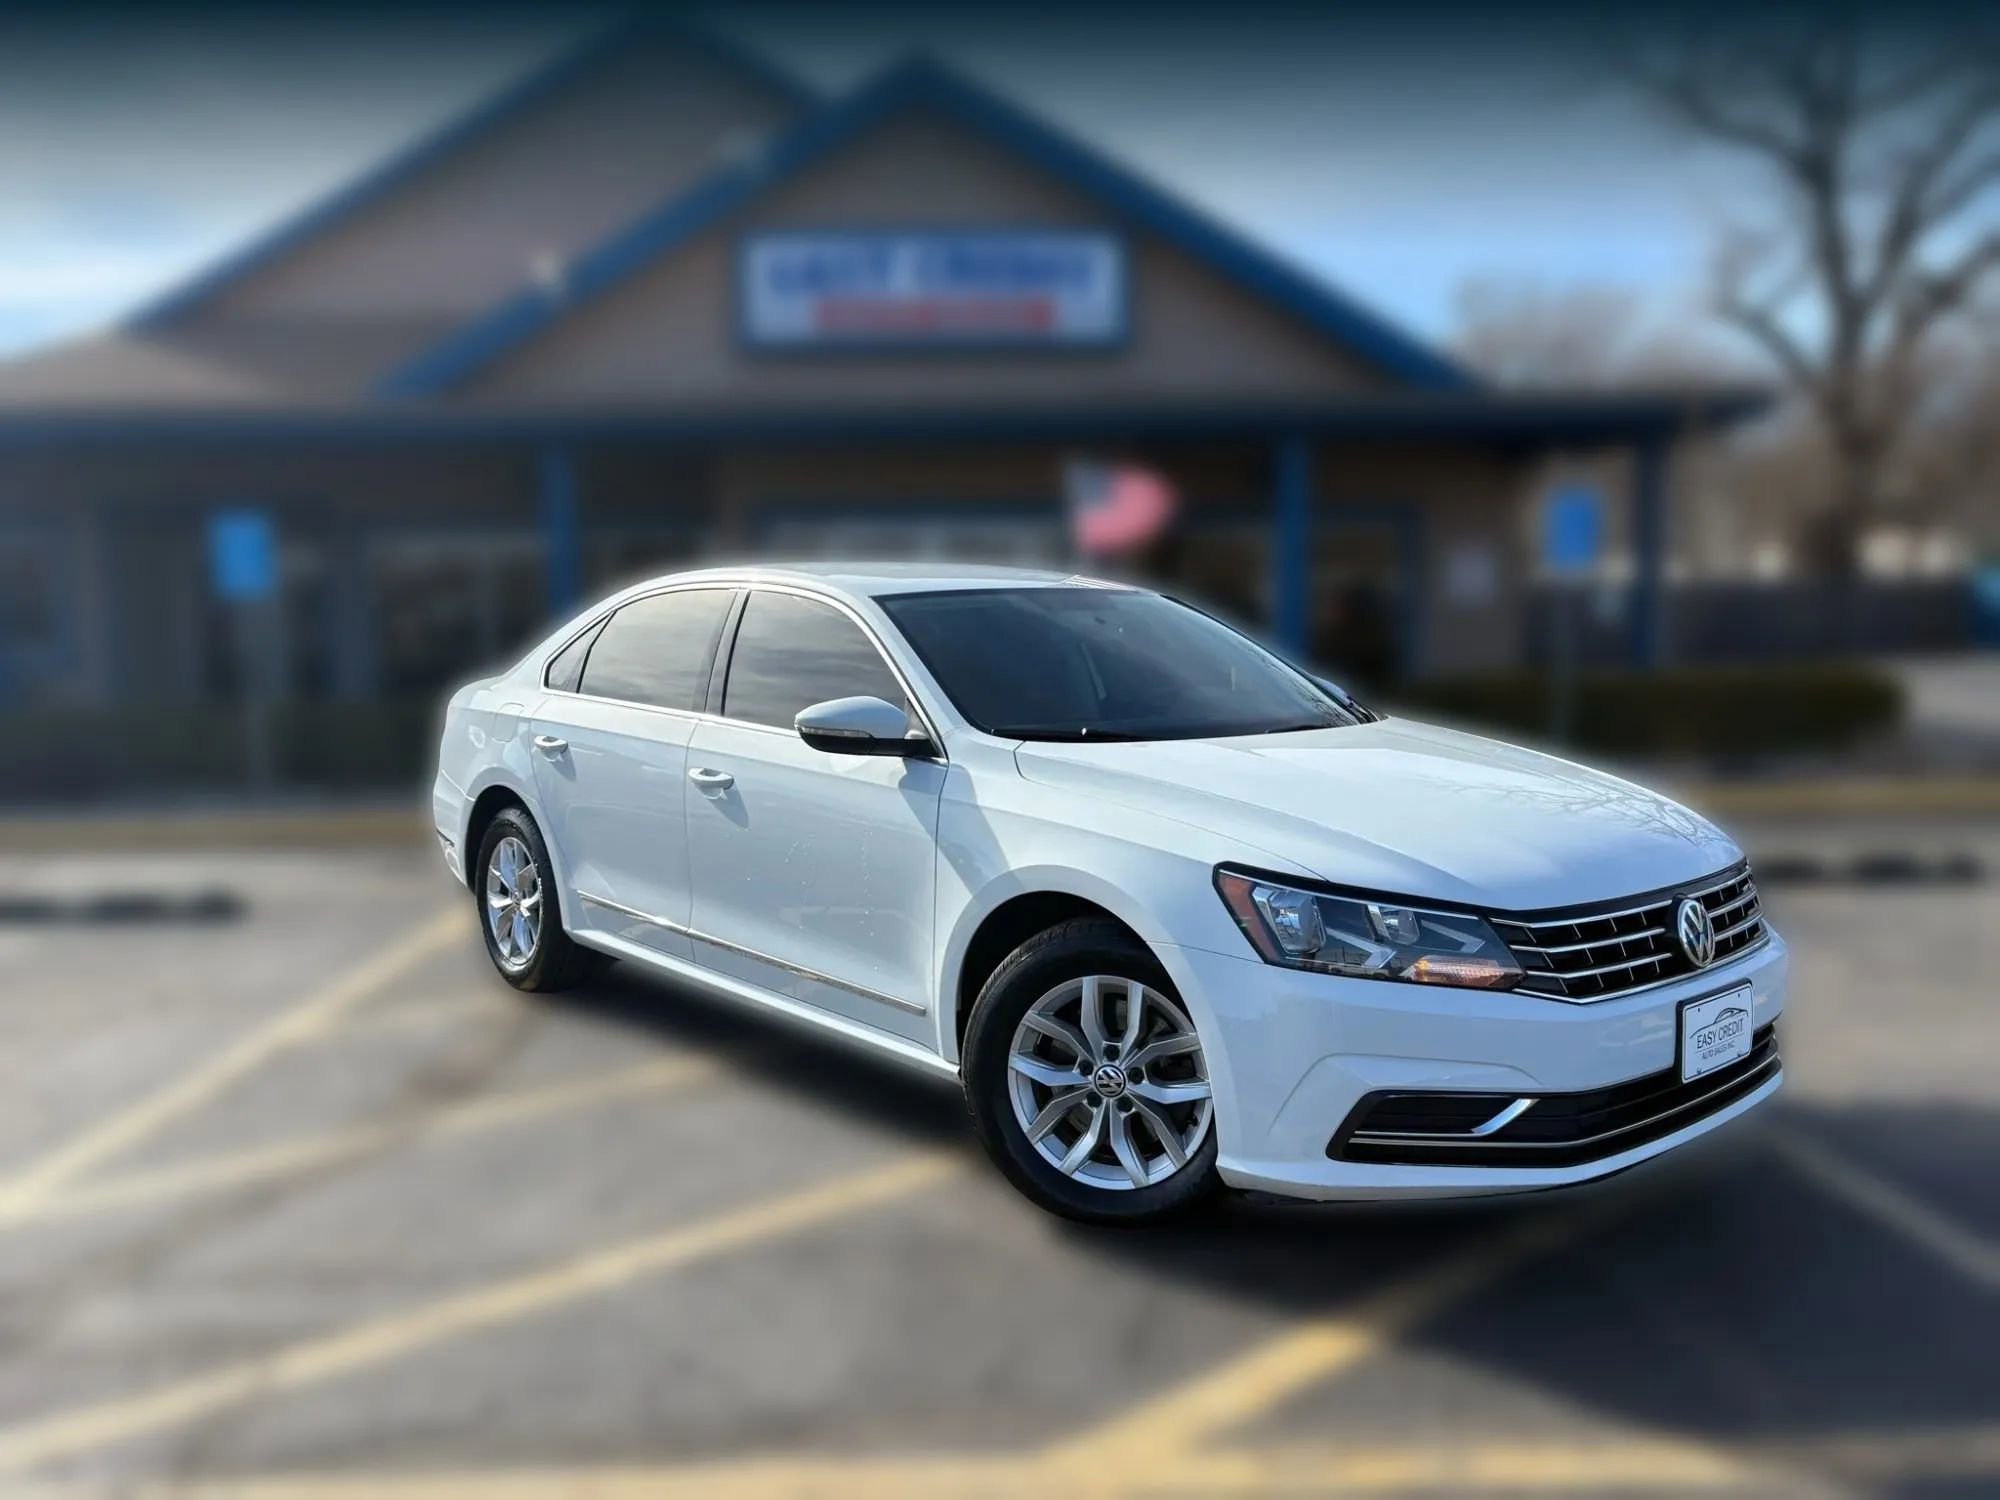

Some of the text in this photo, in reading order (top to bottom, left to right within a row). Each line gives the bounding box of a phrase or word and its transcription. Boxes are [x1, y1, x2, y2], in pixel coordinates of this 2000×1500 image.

[1697, 1018, 1744, 1049] EASY CREDIT
[1702, 1049, 1714, 1059] AUTO
